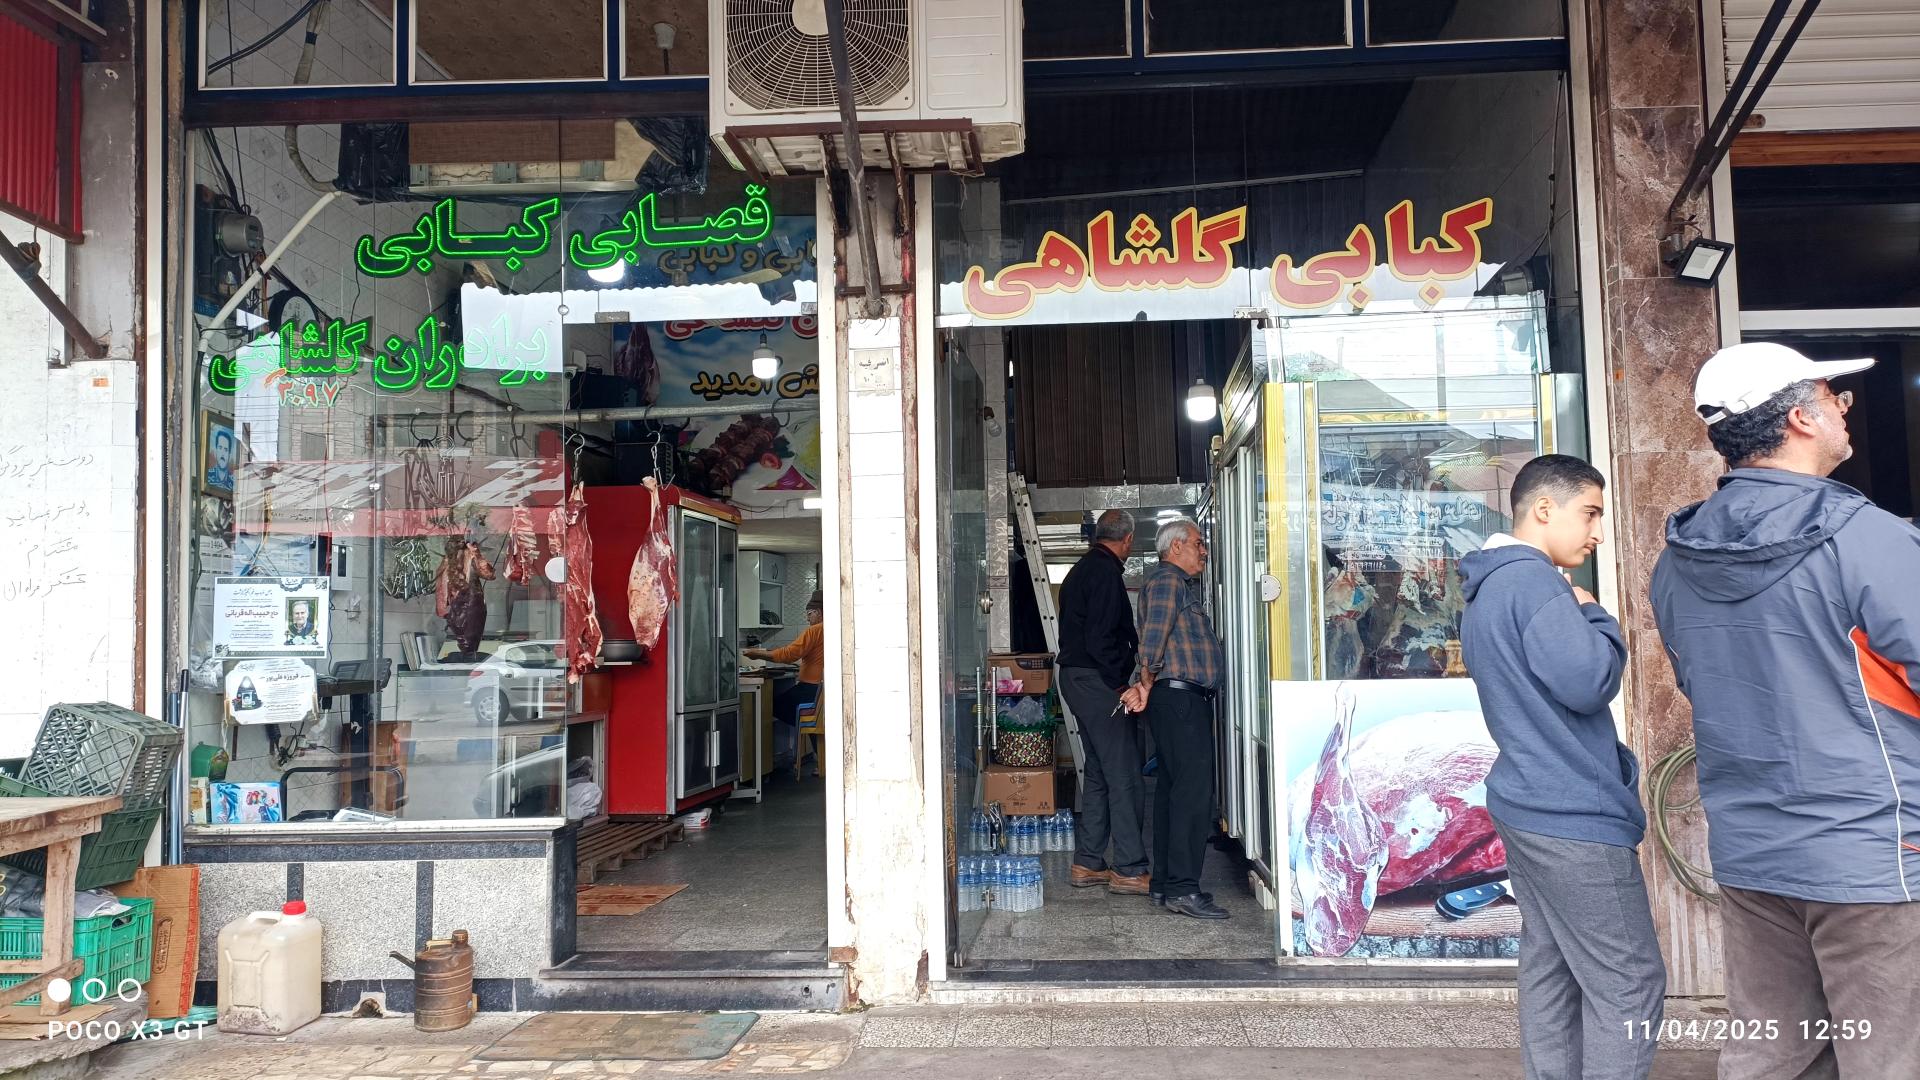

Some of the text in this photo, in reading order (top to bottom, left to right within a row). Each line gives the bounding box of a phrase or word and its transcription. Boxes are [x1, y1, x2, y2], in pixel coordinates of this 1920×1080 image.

[356, 184, 773, 275] قصابی کبابی
[962, 197, 1493, 321] کبابی گلشاهی
[209, 314, 550, 394] برادران گلشاهی
[277, 380, 340, 407] ۳۰۹۷
